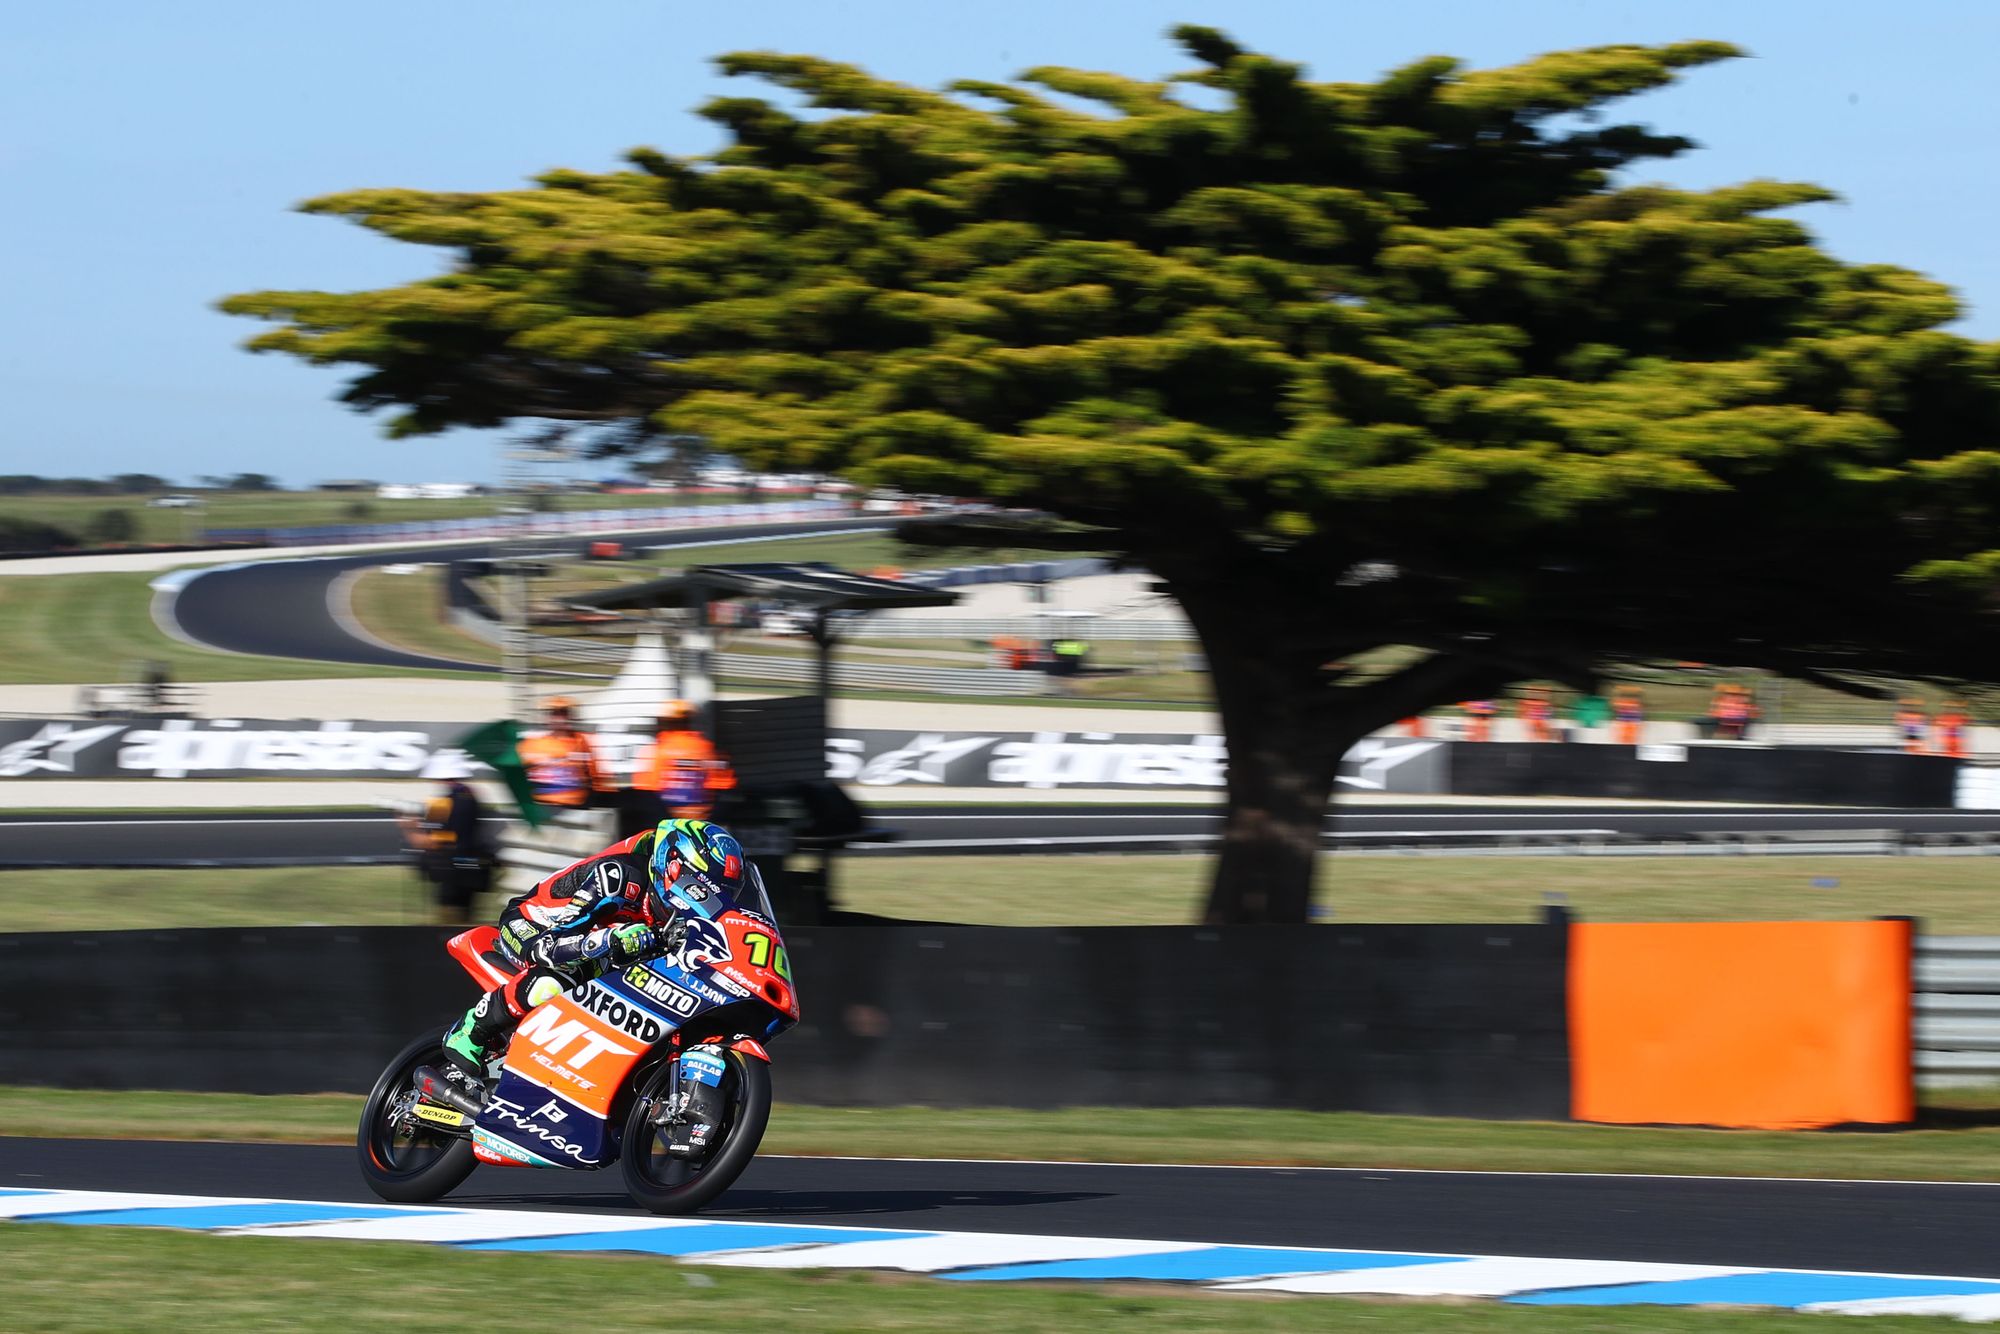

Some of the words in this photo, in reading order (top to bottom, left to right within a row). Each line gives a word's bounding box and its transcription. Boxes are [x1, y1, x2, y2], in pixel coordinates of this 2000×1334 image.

[716, 974, 750, 998] ESP
[572, 983, 660, 1042] OXFORD
[516, 1004, 639, 1070] MT
[530, 1051, 598, 1089] HELMETS
[687, 1060, 721, 1077] DALLAS
[421, 1109, 457, 1121] DUNLOP
[484, 1094, 599, 1164] Frinsa
[689, 1136, 705, 1146] MSI
[486, 1136, 531, 1163] MOTOREX
